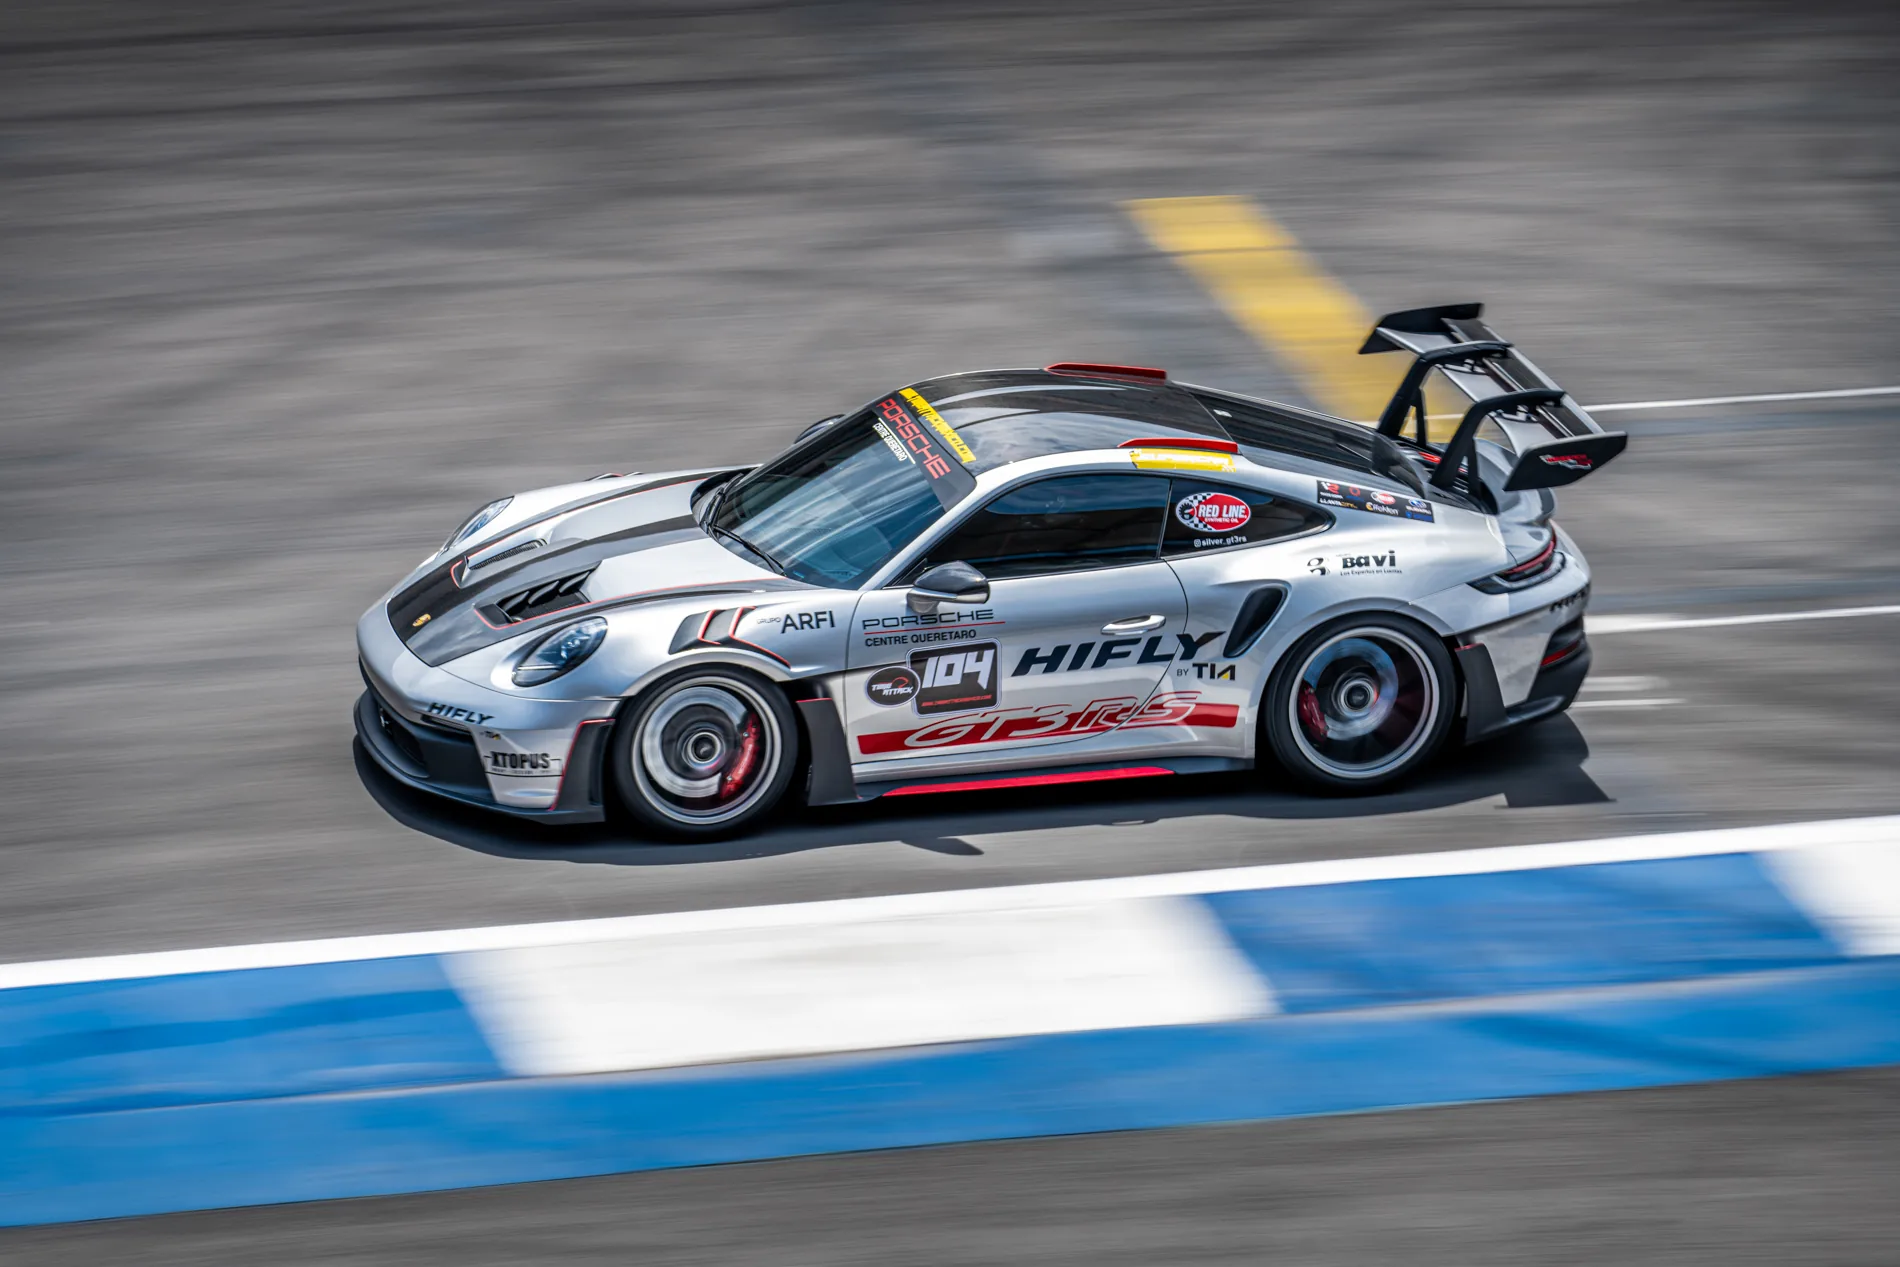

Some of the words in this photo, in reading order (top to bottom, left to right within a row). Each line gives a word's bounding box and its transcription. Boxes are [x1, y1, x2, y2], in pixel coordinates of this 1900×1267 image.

[876, 398, 951, 479] PORSCHE
[1198, 504, 1220, 518] RED
[780, 610, 835, 634] ARFI
[862, 609, 994, 630] PORSCHE
[865, 635, 909, 647] CENTRE
[911, 629, 977, 644] QUERETARO
[1011, 631, 1227, 677] HIFLY
[921, 649, 995, 690] 104
[1176, 668, 1189, 677] BY
[1192, 662, 1236, 681] TIA
[882, 686, 914, 696] ATTACK
[428, 702, 496, 725] HIFLY
